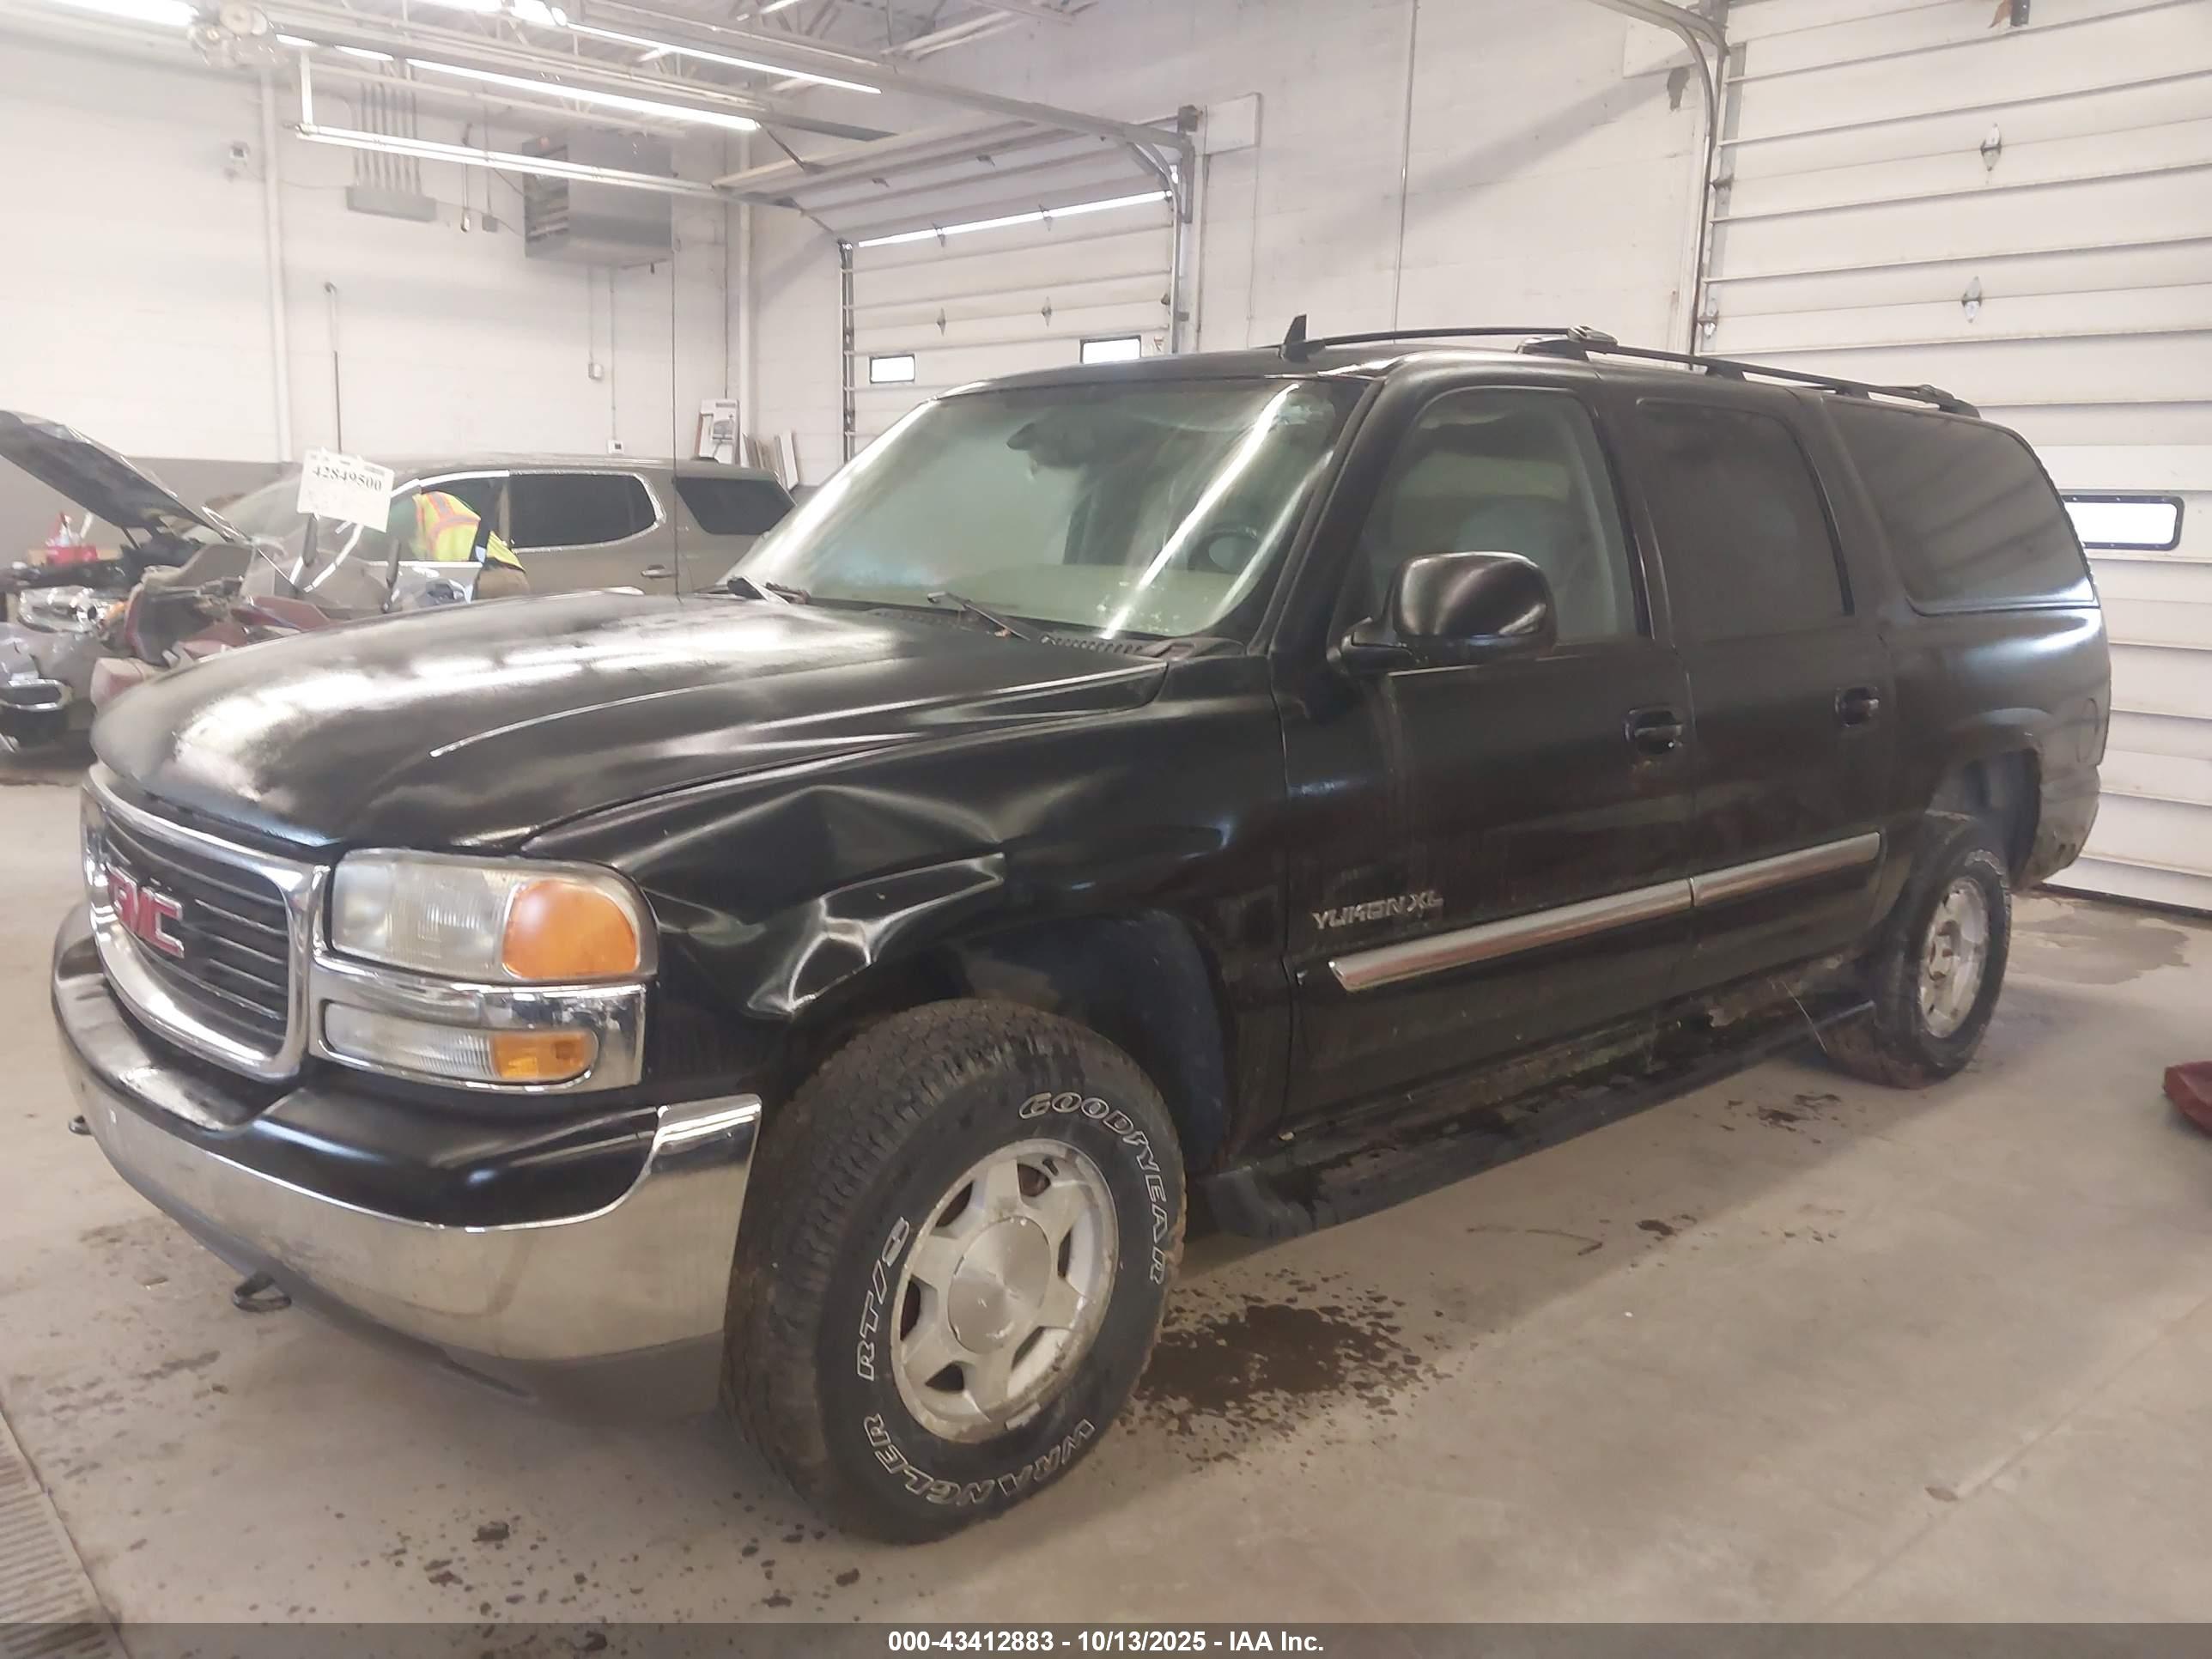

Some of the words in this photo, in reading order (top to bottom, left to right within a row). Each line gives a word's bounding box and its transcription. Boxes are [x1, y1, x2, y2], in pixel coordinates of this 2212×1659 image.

[105, 861, 185, 959] GMC
[1311, 896, 1406, 930] YUKON
[1407, 890, 1444, 913] XL
[1018, 1091, 1168, 1286] GOODYEAR
[861, 1412, 1097, 1507] WRANGLER
